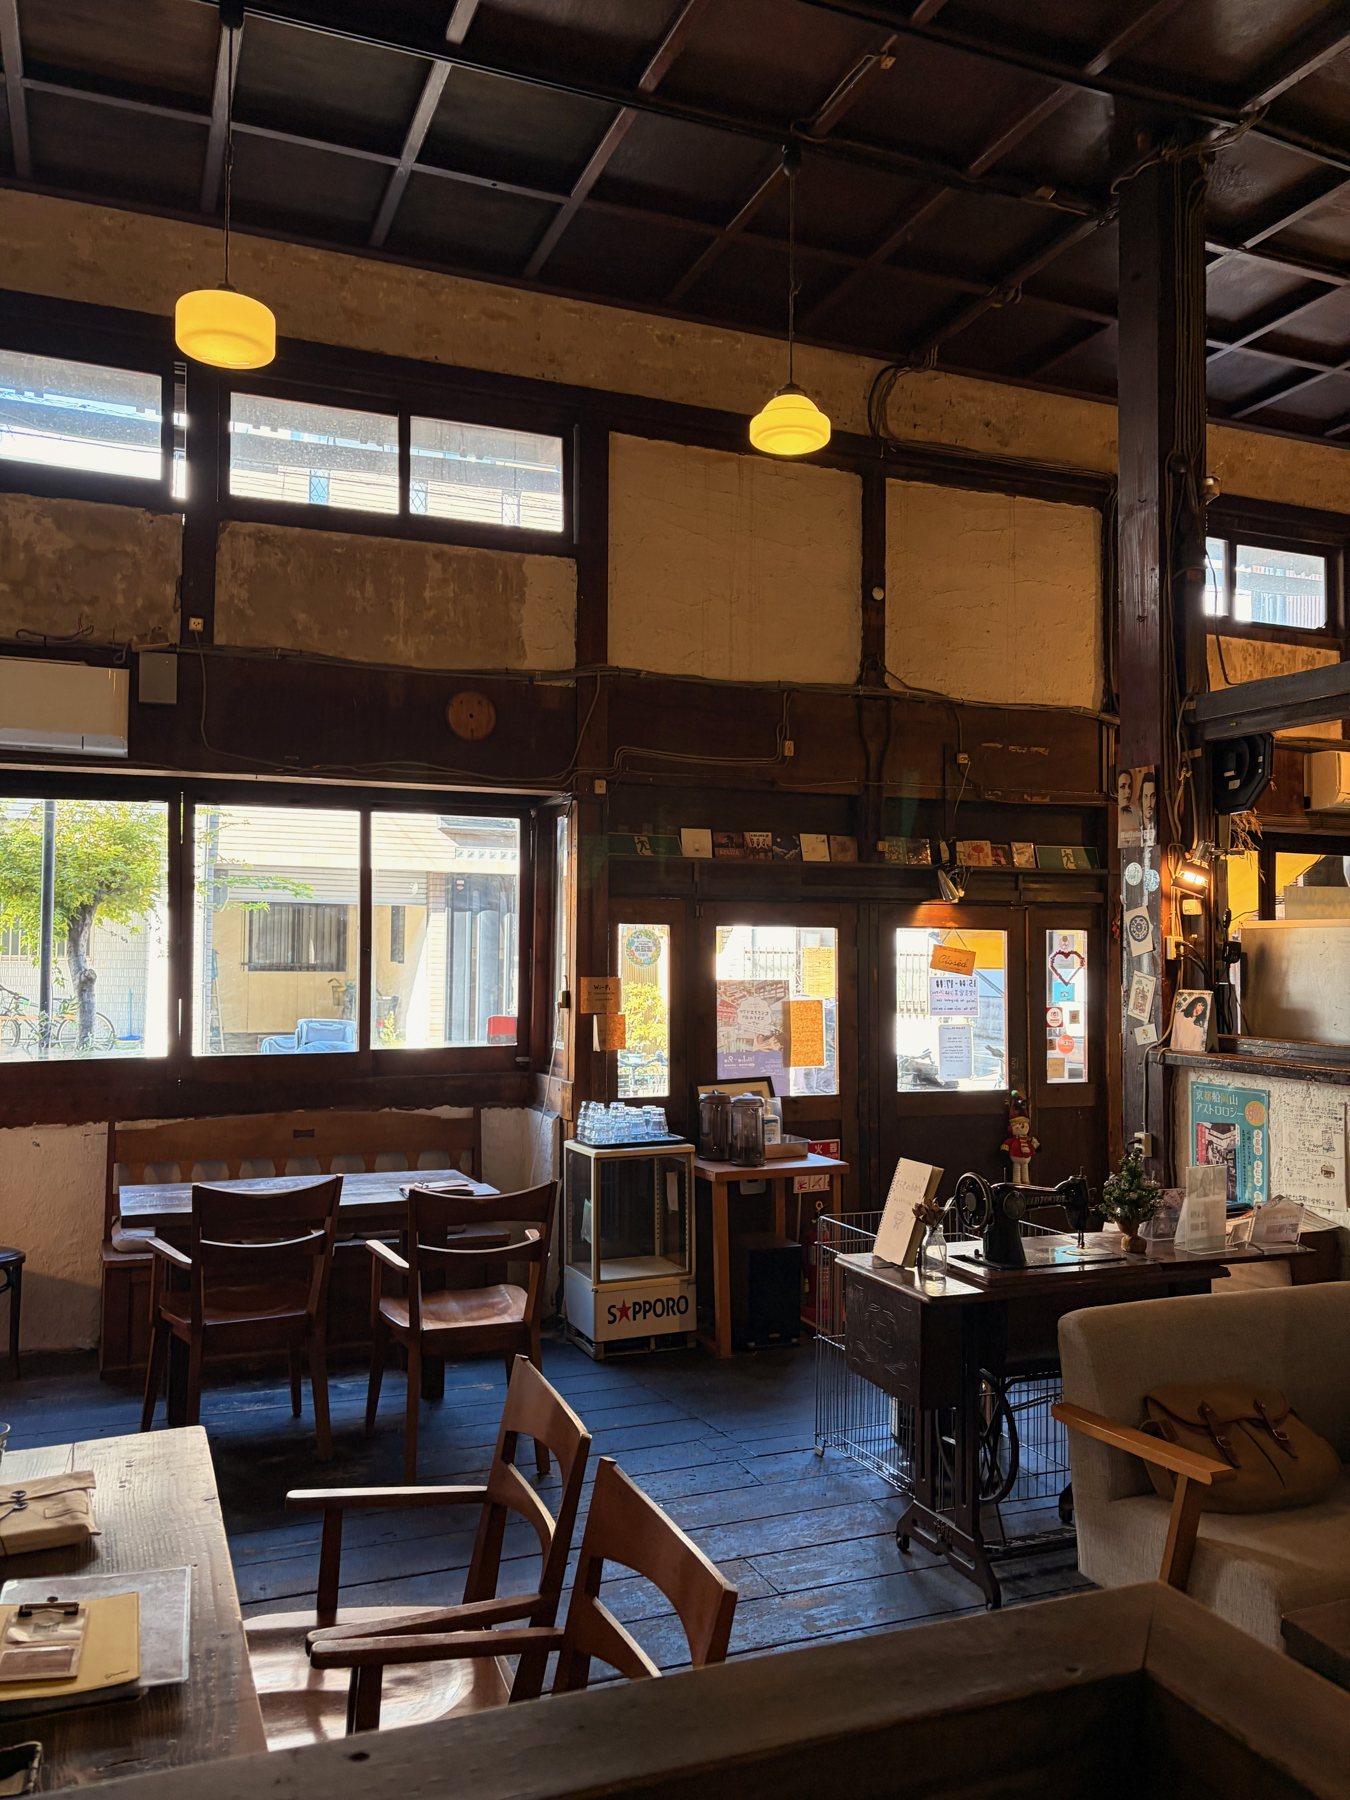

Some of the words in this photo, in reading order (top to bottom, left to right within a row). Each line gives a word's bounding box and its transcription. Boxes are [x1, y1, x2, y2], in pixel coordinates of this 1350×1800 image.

[938, 954, 969, 968] Closed
[1196, 1090, 1238, 1106] 京都船岡山
[1196, 1102, 1244, 1118] アストロロジー
